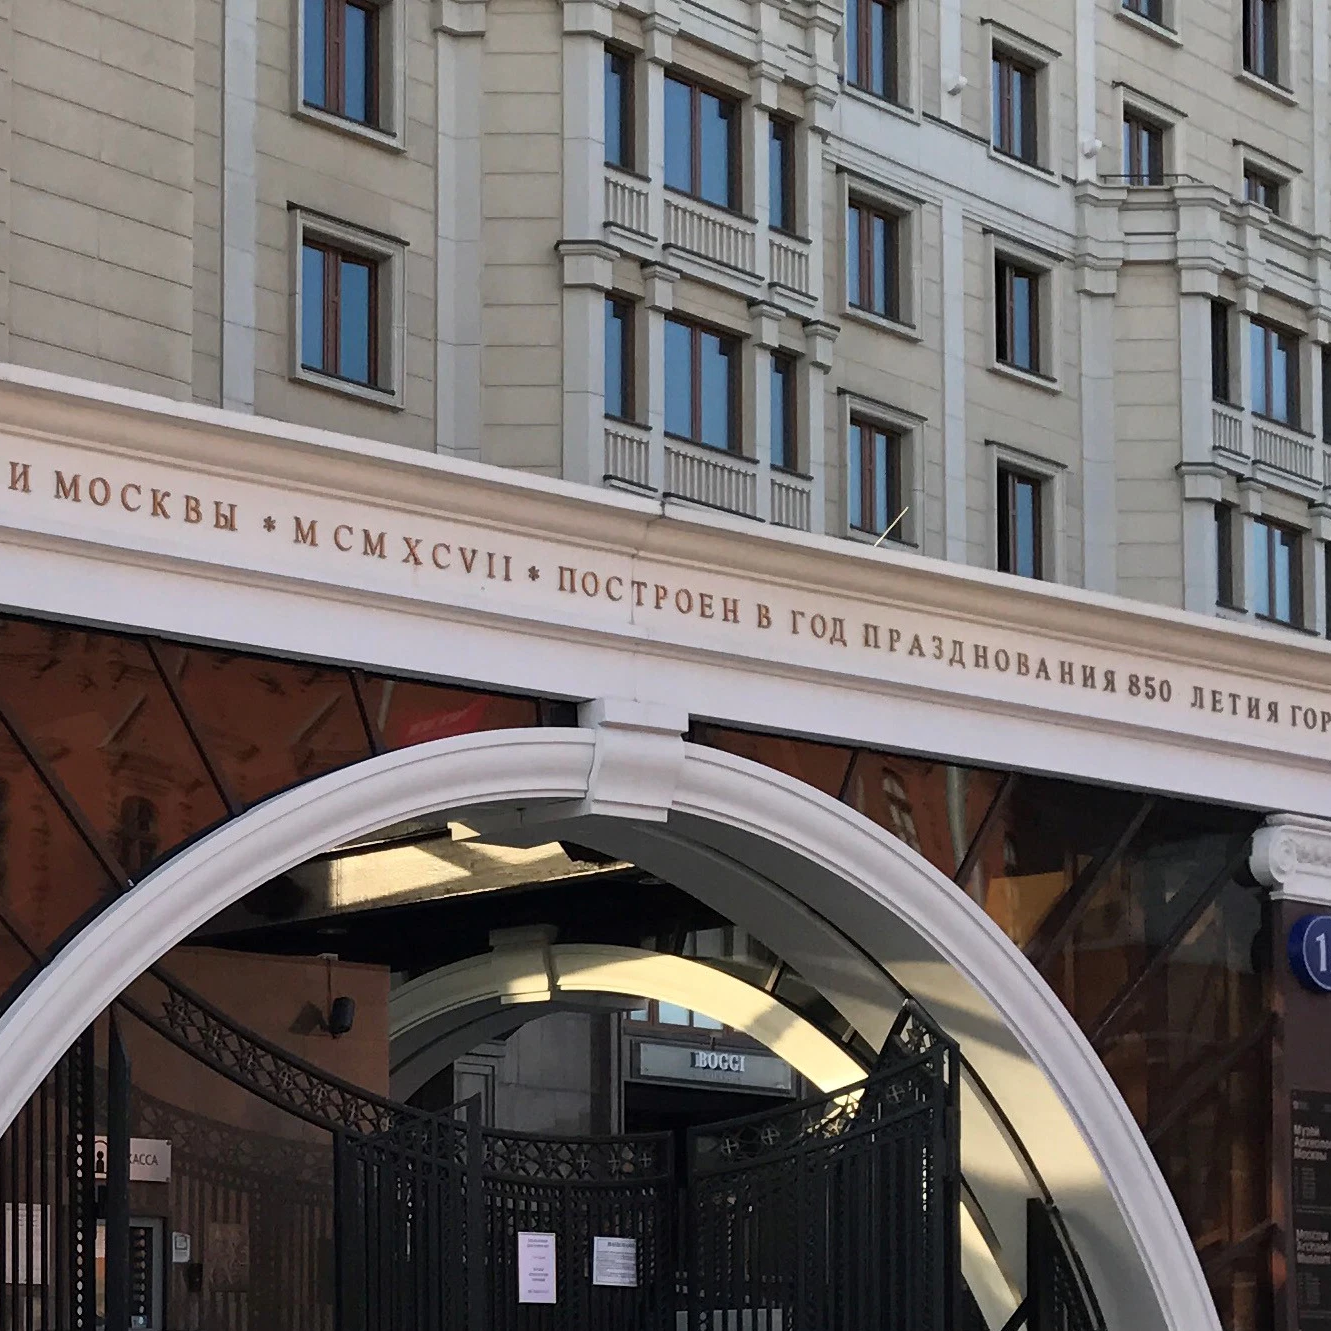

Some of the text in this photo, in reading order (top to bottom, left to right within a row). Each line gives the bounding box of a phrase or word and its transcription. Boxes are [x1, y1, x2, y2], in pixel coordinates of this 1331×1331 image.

[53, 469, 239, 532] МОСКВЫ
[557, 565, 741, 624] ПОСТРОЕН
[756, 603, 772, 629] В
[791, 609, 849, 648] ГОД
[862, 622, 1117, 693] ПРАЗДНОВАНИЯ
[1127, 673, 1173, 702] 850
[1190, 685, 1279, 724] ЛЕТИЯ
